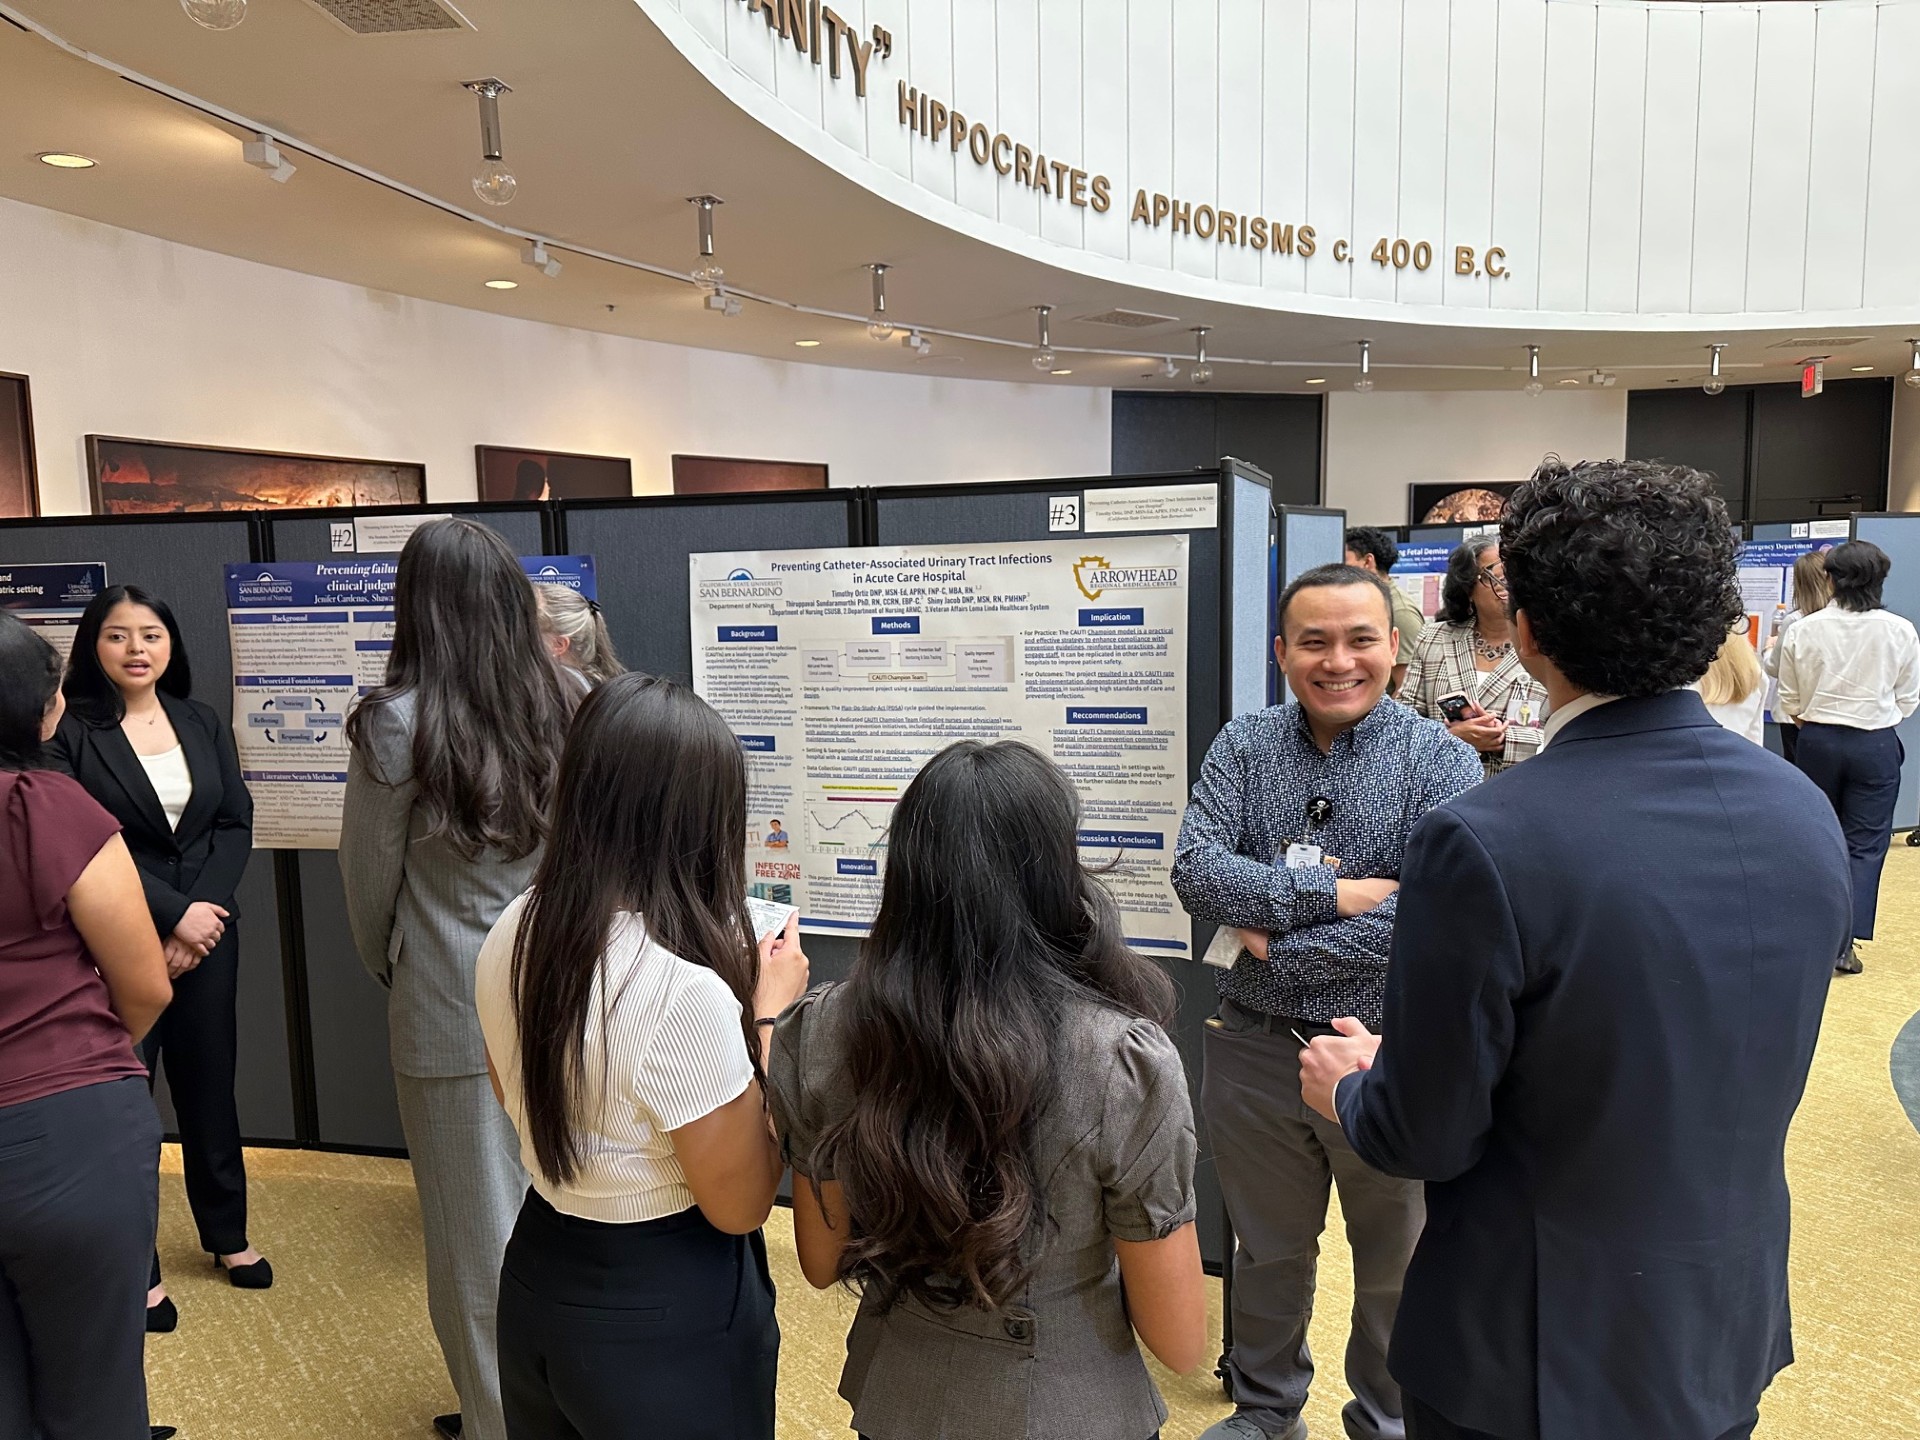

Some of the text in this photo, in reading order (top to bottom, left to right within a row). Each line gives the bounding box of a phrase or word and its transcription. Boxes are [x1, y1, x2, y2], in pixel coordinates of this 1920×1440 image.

[898, 79, 1111, 212] HIPPOCRATES
[1131, 189, 1316, 257] APHORISMS
[1333, 239, 1354, 263] c.
[1371, 237, 1432, 270] 400
[1455, 245, 1511, 279] B.C.
[1050, 504, 1077, 526] #3
[332, 530, 352, 547] #2
[1406, 548, 1423, 556] Fetal
[1423, 547, 1449, 555] Demise
[771, 553, 1052, 573] Preventing Catheter-Associated Urinary Tract Infections
[316, 564, 371, 577] Preventing
[853, 570, 966, 584] in Acute Care Hospital
[1090, 569, 1177, 583] ARROWHEAD
[16, 585, 44, 594] setting
[326, 580, 363, 591] clinical
[700, 587, 783, 598] SAN BERNARDINO
[832, 590, 854, 598] Timothy
[854, 589, 869, 597] Ortiz
[752, 602, 775, 610] Nursing
[272, 615, 308, 623] Background
[1090, 614, 1131, 622] Implication
[258, 677, 291, 685] Theoretical
[1118, 836, 1157, 844] Conclusion
[755, 862, 801, 871] INFECTION
[840, 863, 873, 871] Innovation
[755, 870, 776, 878] FREE
